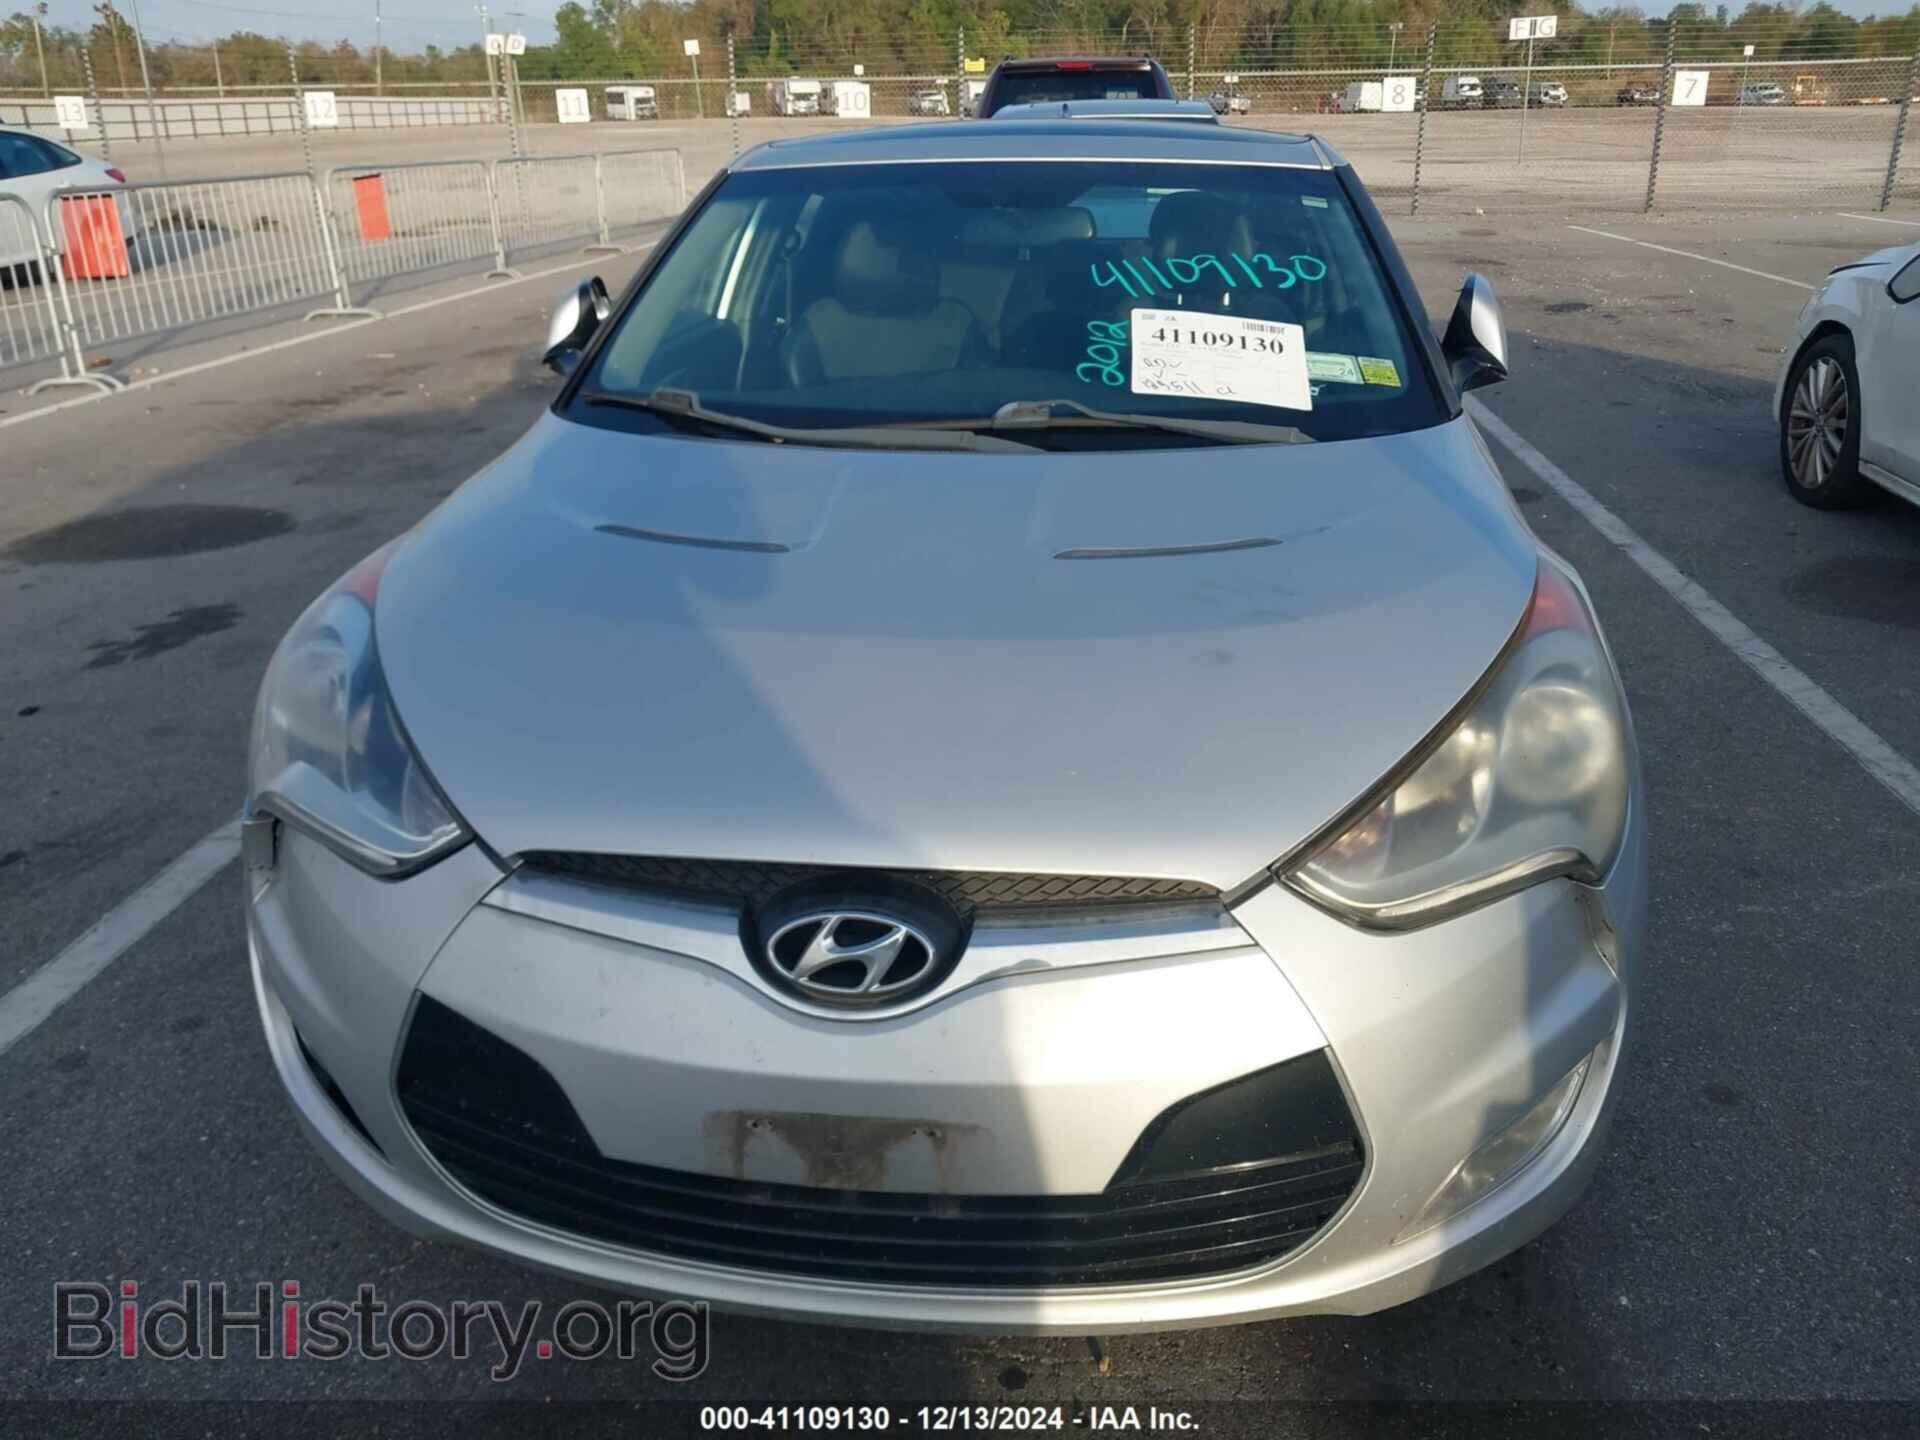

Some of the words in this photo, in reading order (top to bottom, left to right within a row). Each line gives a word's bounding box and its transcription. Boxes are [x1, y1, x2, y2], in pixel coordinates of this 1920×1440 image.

[1514, 19, 1527, 37] F
[1539, 18, 1553, 35] G
[1392, 84, 1405, 104] 8
[1685, 78, 1698, 98] 7
[310, 99, 335, 118] 12
[561, 96, 585, 116] 11
[840, 91, 867, 110] 10
[59, 103, 84, 121] 13
[1091, 253, 1327, 298] 41109130
[1152, 327, 1285, 355] 41109130
